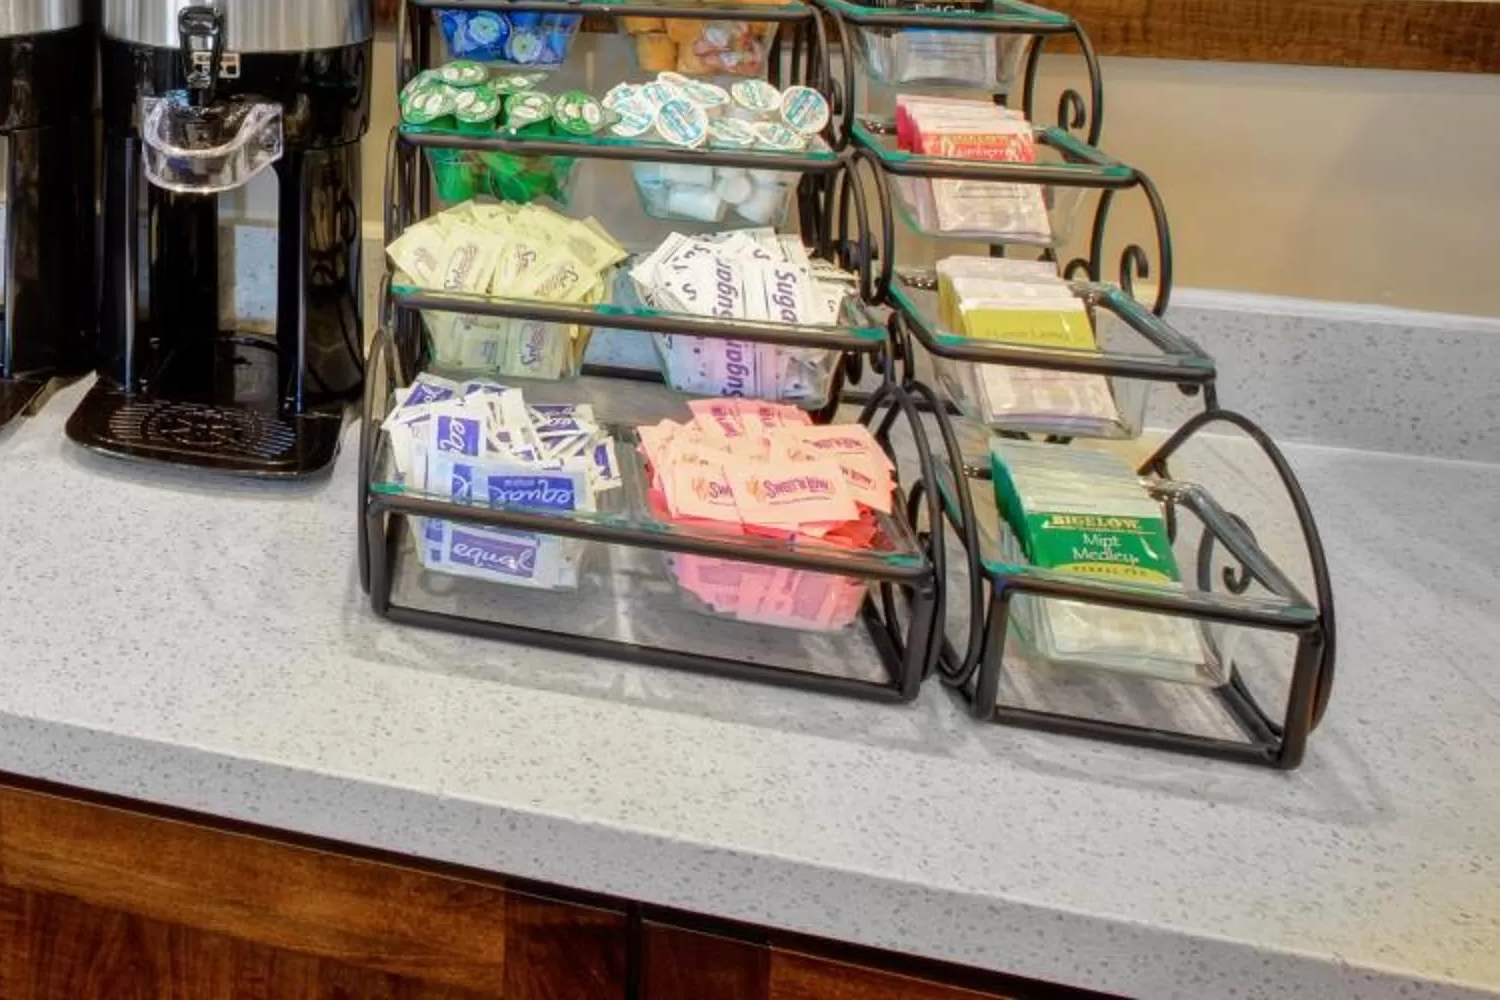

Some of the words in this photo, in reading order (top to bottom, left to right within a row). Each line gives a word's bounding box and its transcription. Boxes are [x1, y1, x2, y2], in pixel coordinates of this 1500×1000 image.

[713, 258, 739, 318] Sugar
[772, 269, 798, 324] Suga
[721, 338, 749, 397] Sugar
[1051, 514, 1142, 530] BIGELOW
[1083, 533, 1122, 548] Mint
[452, 541, 536, 572] equal
